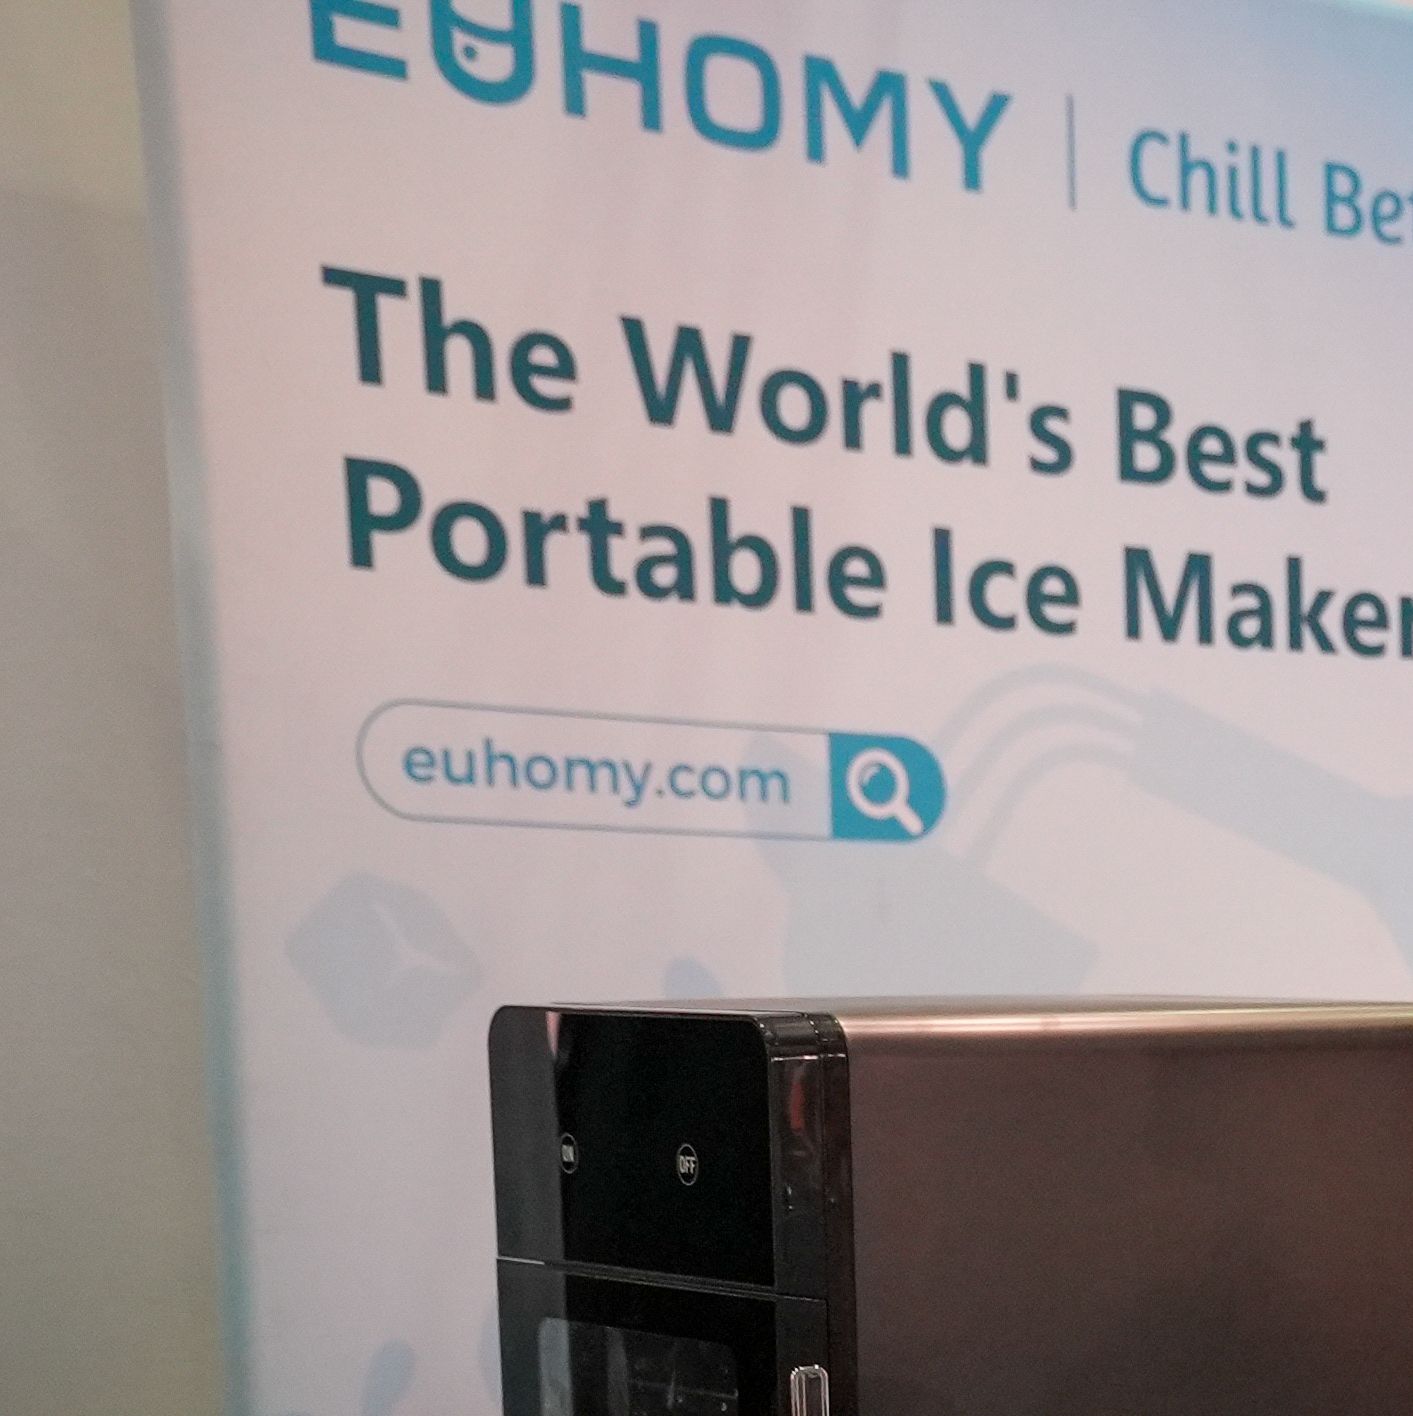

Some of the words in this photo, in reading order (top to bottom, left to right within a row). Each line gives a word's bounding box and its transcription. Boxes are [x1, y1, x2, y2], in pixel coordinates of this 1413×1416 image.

[308, 0, 1012, 192] EUHOMY
[1129, 129, 1295, 228] Chill
[320, 265, 579, 413] The
[620, 315, 1075, 476] World's
[1116, 386, 1328, 504] Best
[343, 454, 888, 622] Portable
[932, 526, 1081, 636] Ice
[402, 737, 792, 807] euhomy.com
[679, 1155, 697, 1174] OFF
